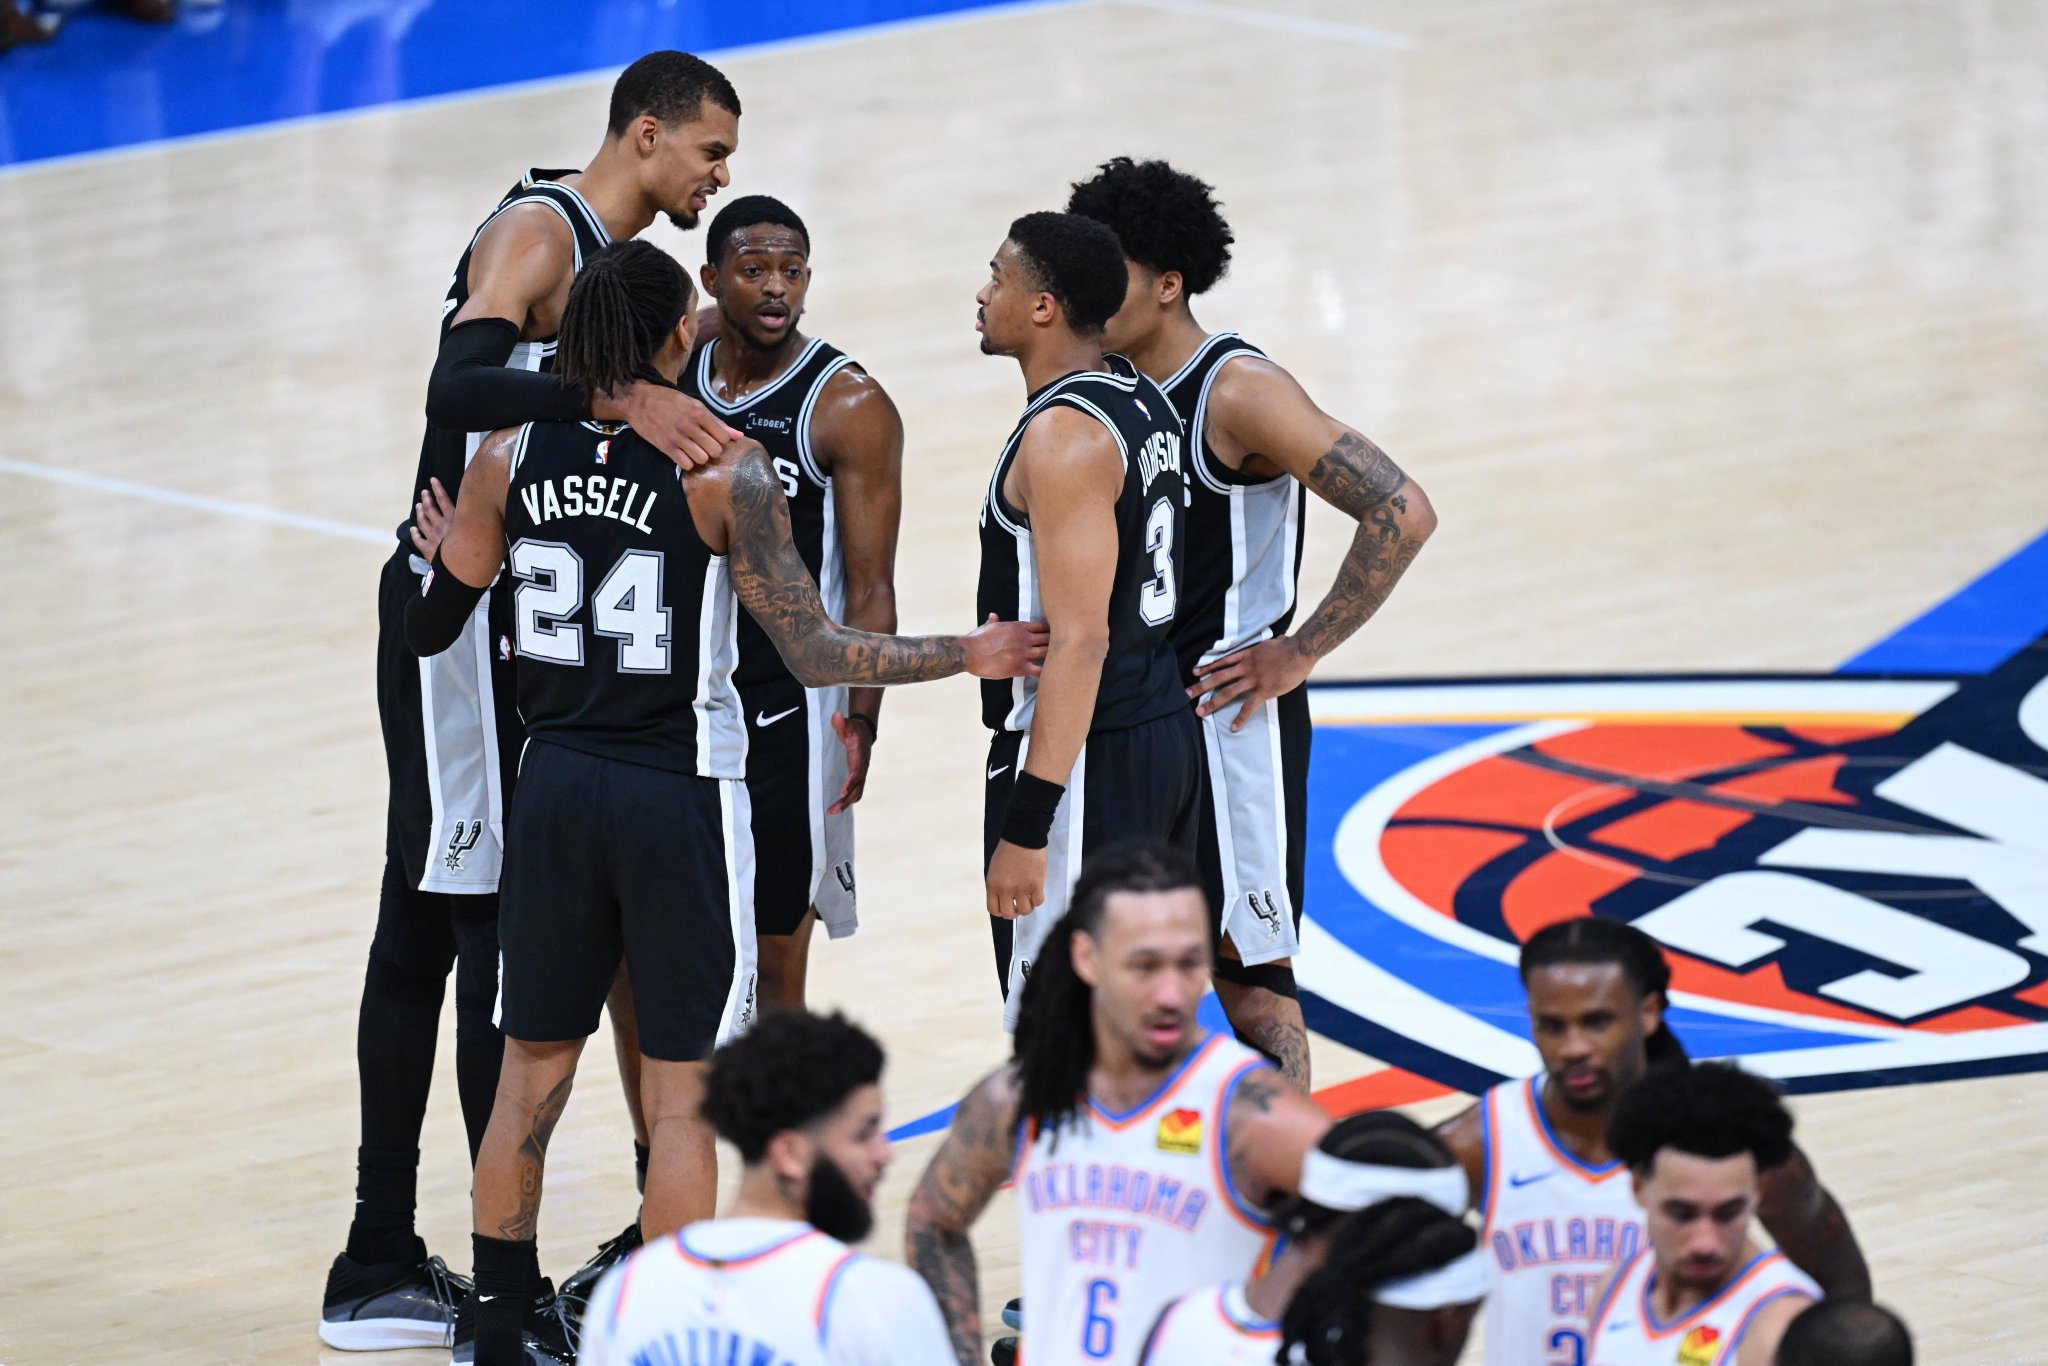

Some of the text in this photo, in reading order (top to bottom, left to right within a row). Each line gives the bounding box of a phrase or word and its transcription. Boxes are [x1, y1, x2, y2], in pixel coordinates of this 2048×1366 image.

[752, 417, 785, 429] LEDGER
[521, 475, 658, 534] VASSELL
[1139, 495, 1177, 627] 3
[509, 537, 673, 675] 24
[1026, 1164, 1209, 1234] OKLAHOMA
[1070, 1219, 1143, 1270] CITY
[1491, 1216, 1643, 1272] OKLAHO
[1081, 1278, 1119, 1360] 6
